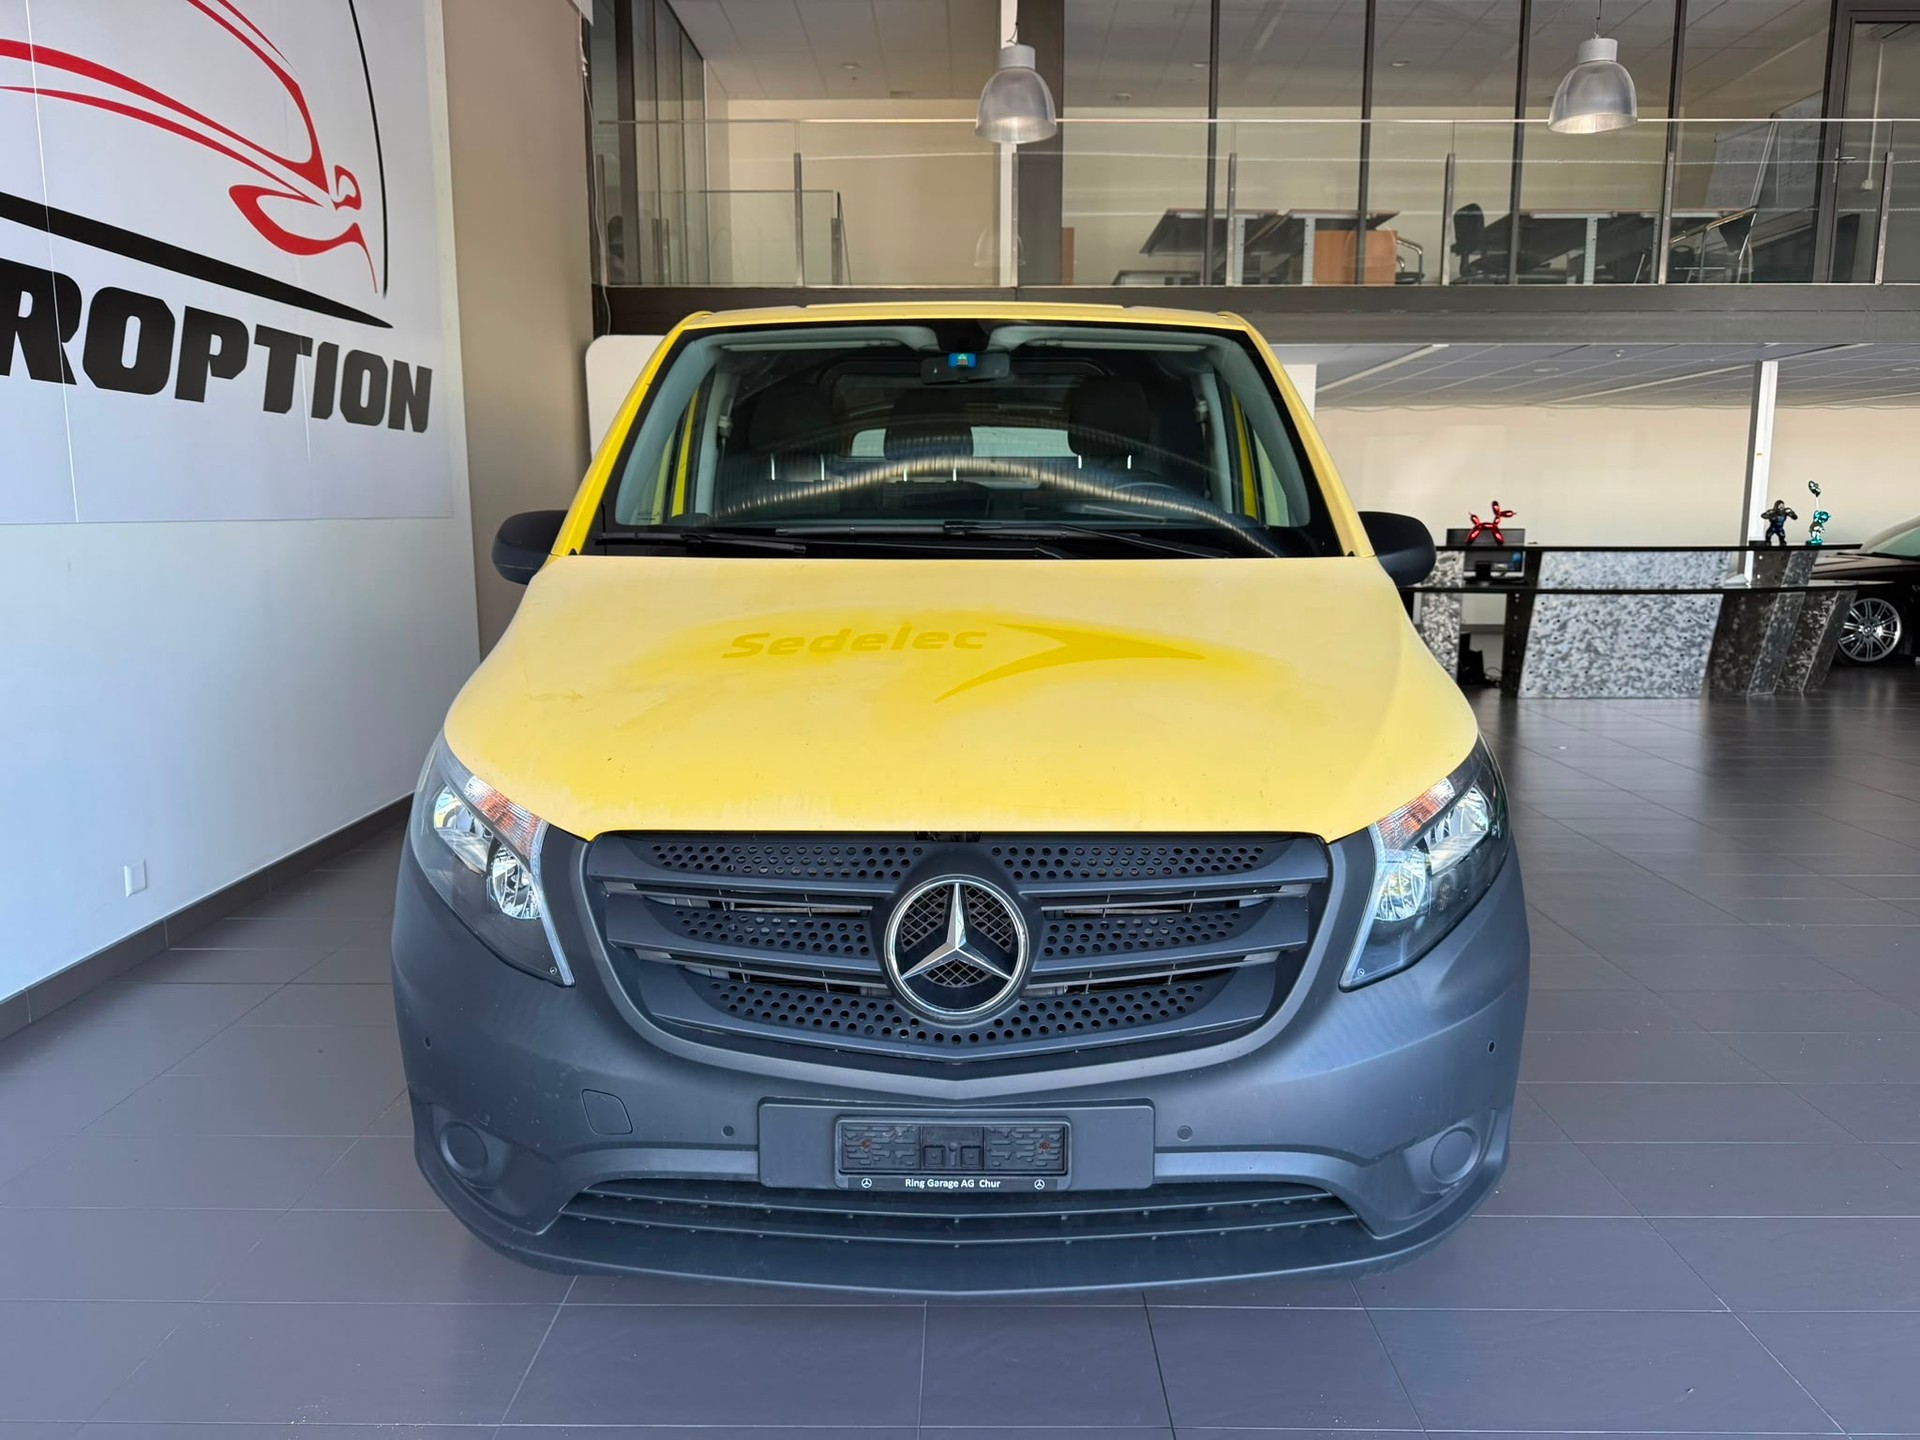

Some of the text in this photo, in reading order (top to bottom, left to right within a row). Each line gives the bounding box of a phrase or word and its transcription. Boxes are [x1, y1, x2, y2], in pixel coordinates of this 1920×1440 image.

[721, 625, 988, 659] Sedelec
[905, 1178, 1001, 1190] Ring Garage AG Chur
